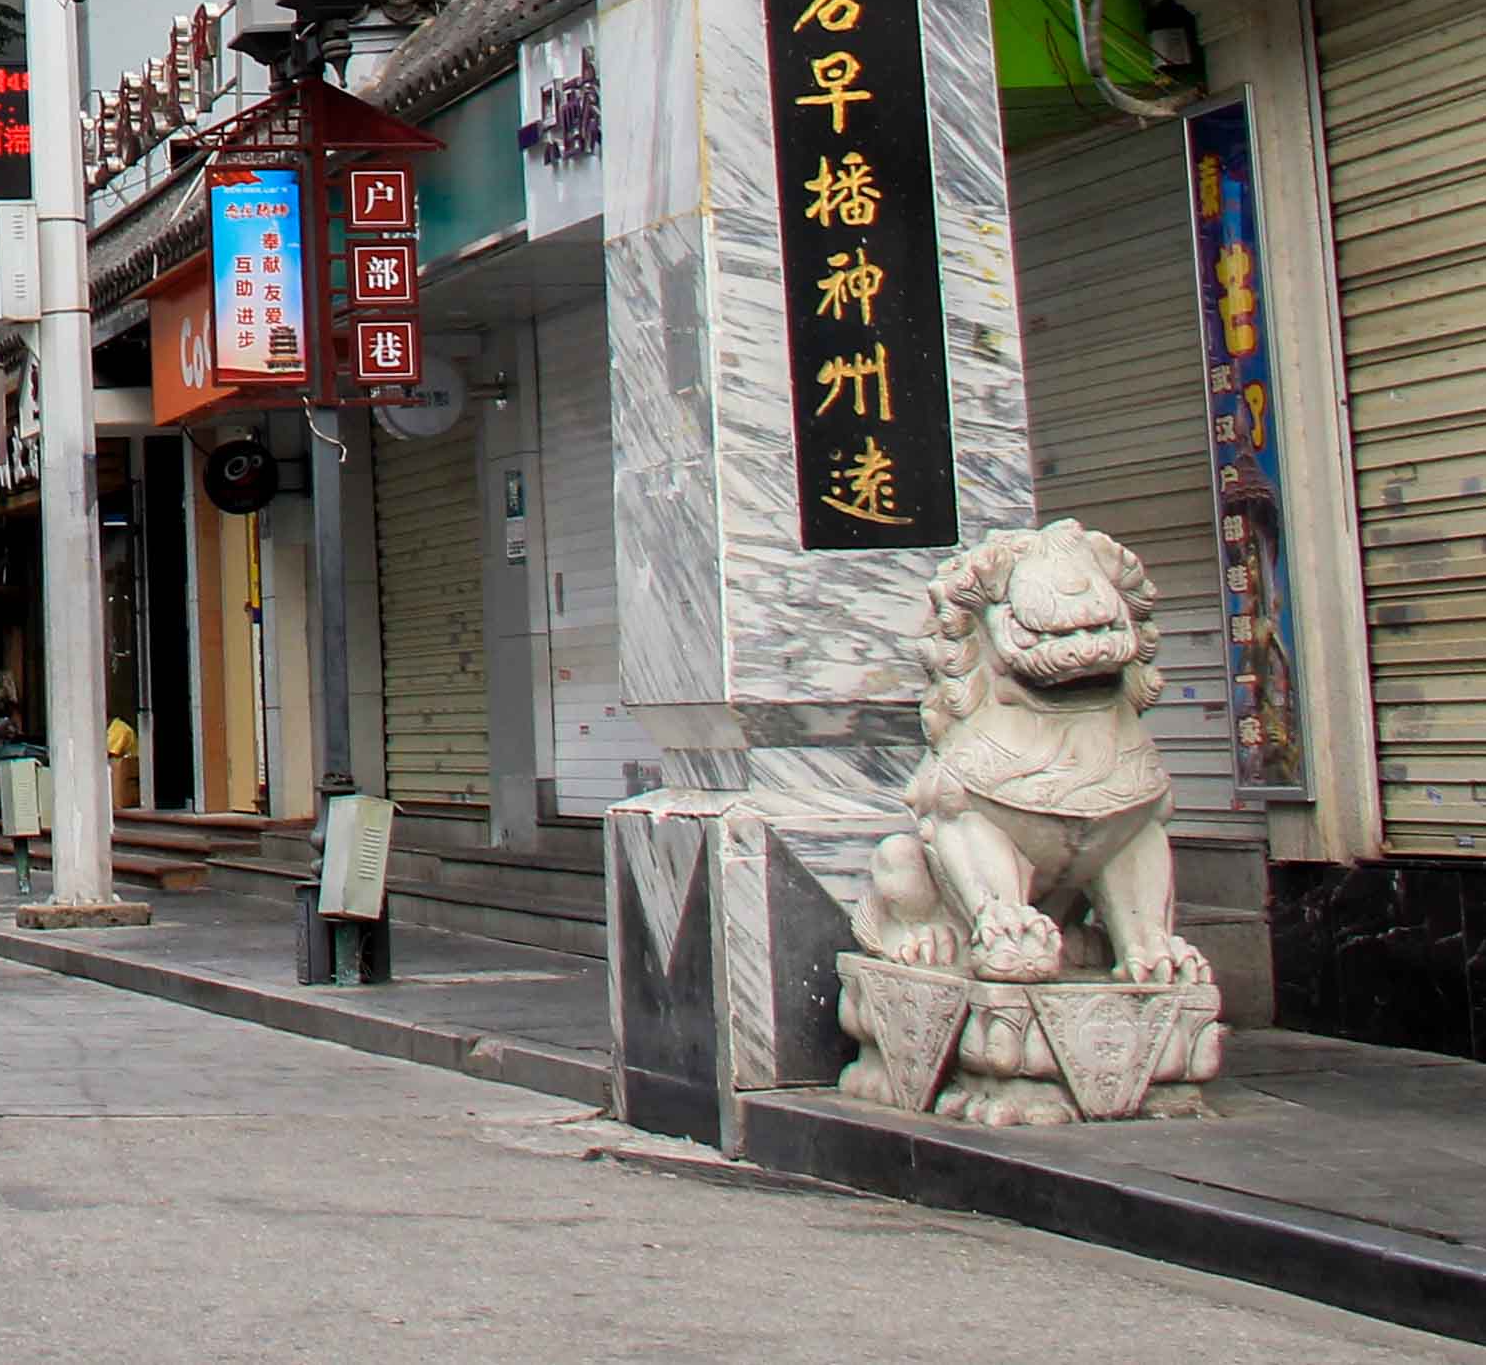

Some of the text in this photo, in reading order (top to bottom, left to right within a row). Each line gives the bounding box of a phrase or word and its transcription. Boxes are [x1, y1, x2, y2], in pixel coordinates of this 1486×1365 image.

[235, 256, 255, 348] 互助进步
[364, 180, 404, 368] 户部巷
